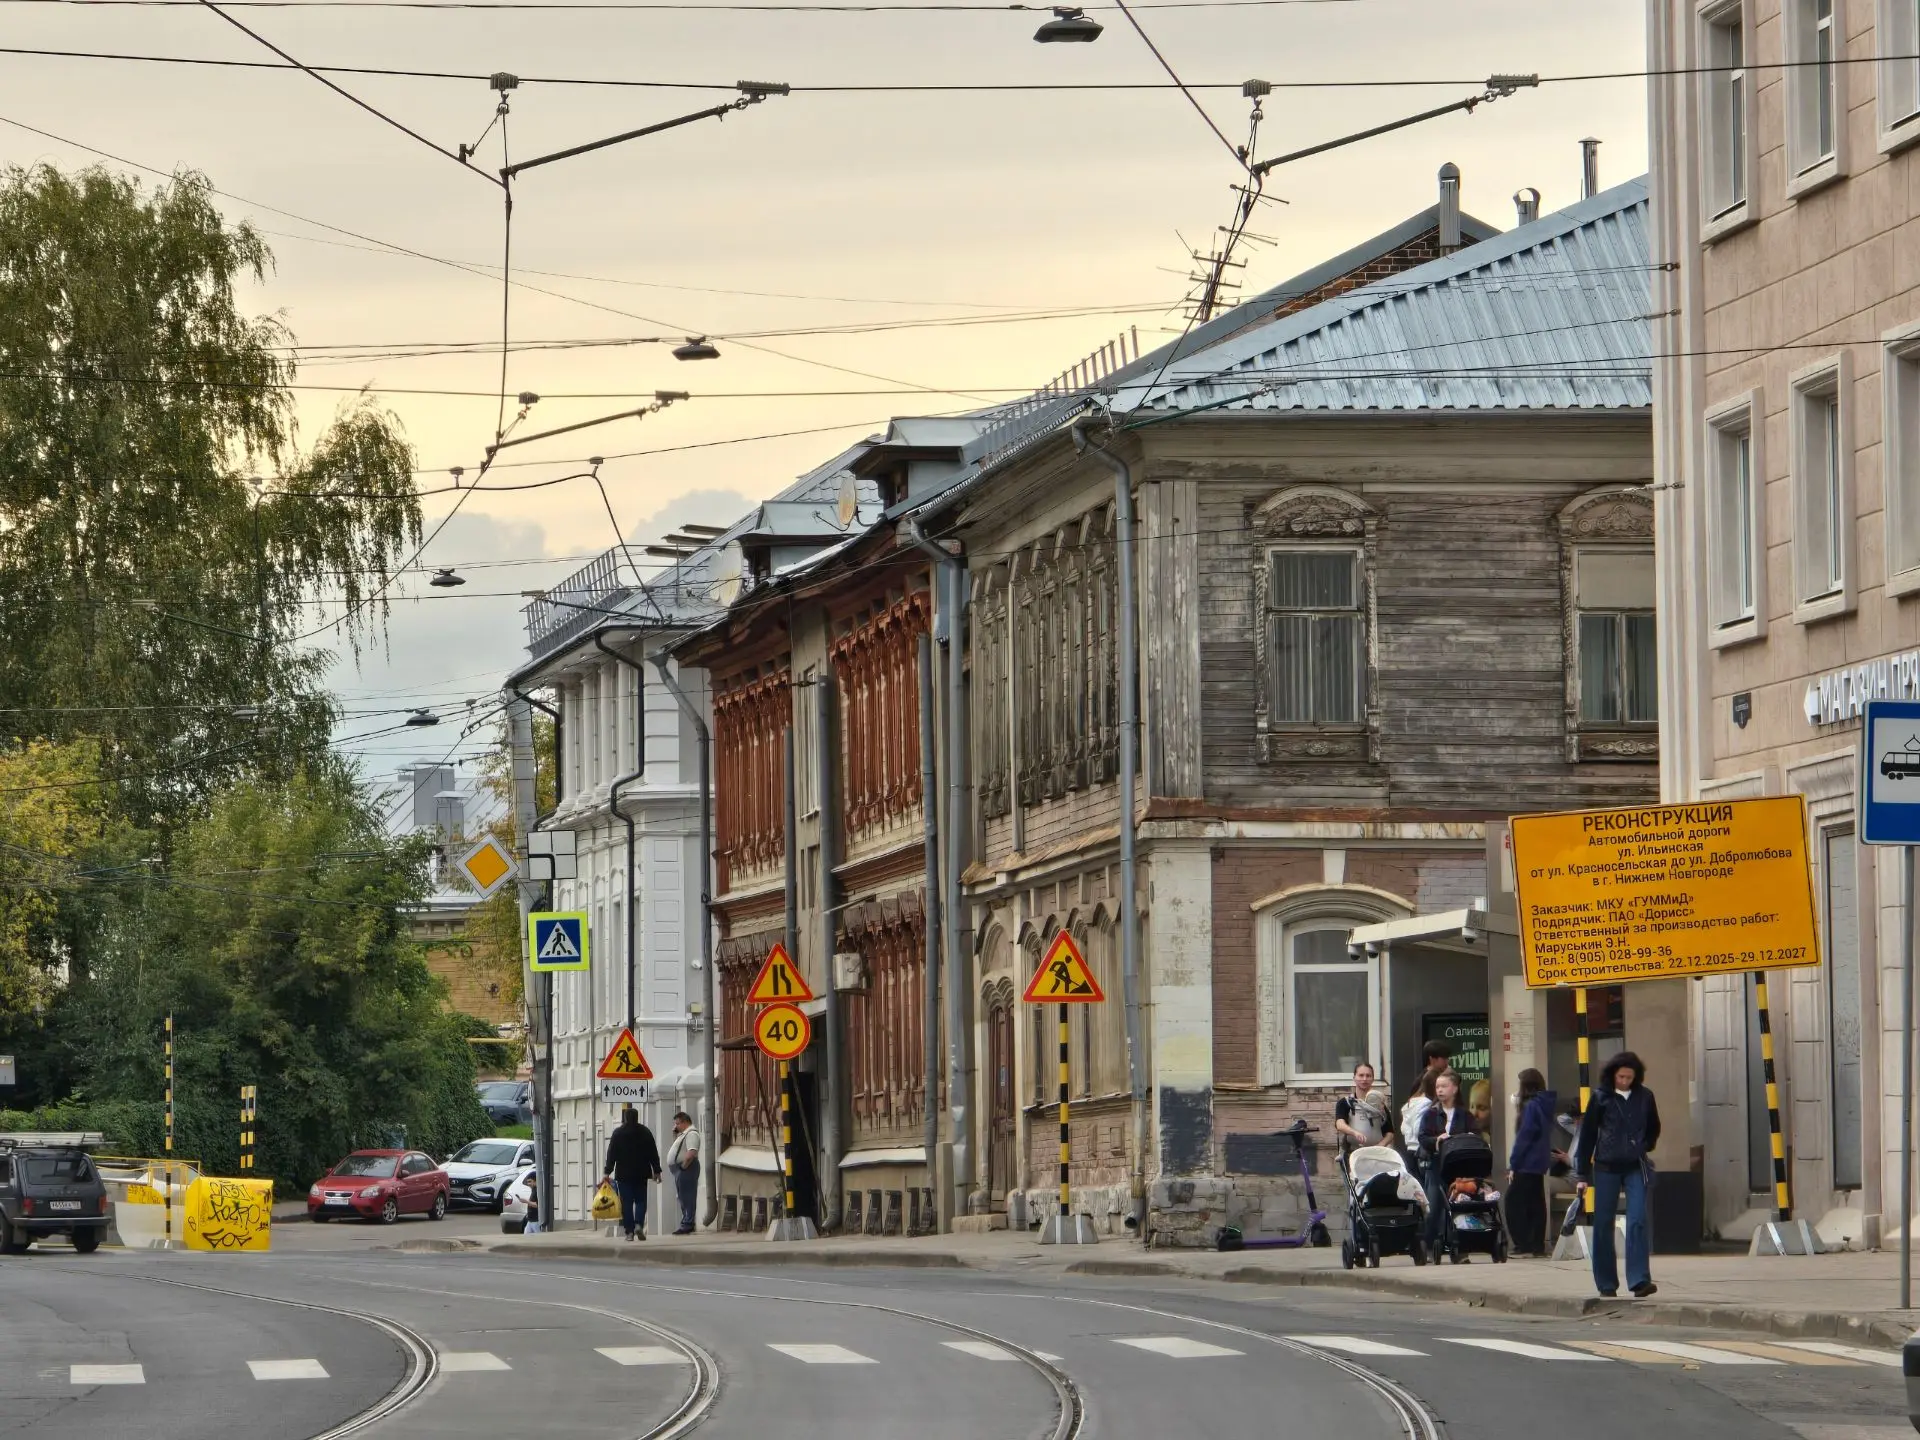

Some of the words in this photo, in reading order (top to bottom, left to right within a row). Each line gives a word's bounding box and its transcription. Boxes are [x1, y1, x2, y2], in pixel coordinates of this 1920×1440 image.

[1819, 659, 1887, 724] МАГАЗИН
[1891, 649, 1920, 700] ПРЯ
[1583, 805, 1733, 832] РЕКОНСТРУКЦИЯ
[1588, 828, 1684, 847] Автомобильной
[1688, 826, 1730, 841] дороги
[1618, 848, 1634, 860] ул.
[1638, 842, 1704, 857] Ильинская
[1530, 868, 1544, 878] от
[1548, 866, 1565, 879] ул.
[1568, 858, 1667, 877] Красносельская
[1671, 856, 1686, 868] до
[1690, 854, 1706, 869] ул.
[1710, 848, 1792, 865] Добролюбова
[1593, 877, 1600, 886] в
[1603, 876, 1612, 886] г.
[1615, 872, 1665, 885] Нижнем
[1669, 866, 1734, 881] Новгороде
[1531, 902, 1593, 916] Заказчик:
[1597, 898, 1624, 911] МКУ
[1628, 893, 1694, 908] «ГУММиД»
[1532, 915, 1606, 930] Подрядчик:
[1609, 910, 1635, 922] ПАО
[1639, 908, 1695, 921] «Дорисс»
[1534, 923, 1630, 941] Ответственный
[1633, 924, 1647, 933] за
[1651, 916, 1736, 934] производство
[1740, 912, 1780, 927] работ:
[1535, 940, 1603, 955] Маруськин
[1605, 937, 1630, 948] Э.Н.
[1536, 955, 1564, 967] Тел.:
[1567, 951, 1606, 966] 8(905)
[1609, 945, 1672, 961] 028-99-36
[1537, 968, 1568, 980] Срок
[1571, 960, 1665, 977] строительства:
[1668, 947, 1807, 969] 22.12.2025-29.12.2027
[766, 1020, 798, 1041] 40
[611, 1086, 637, 1096] 100м
